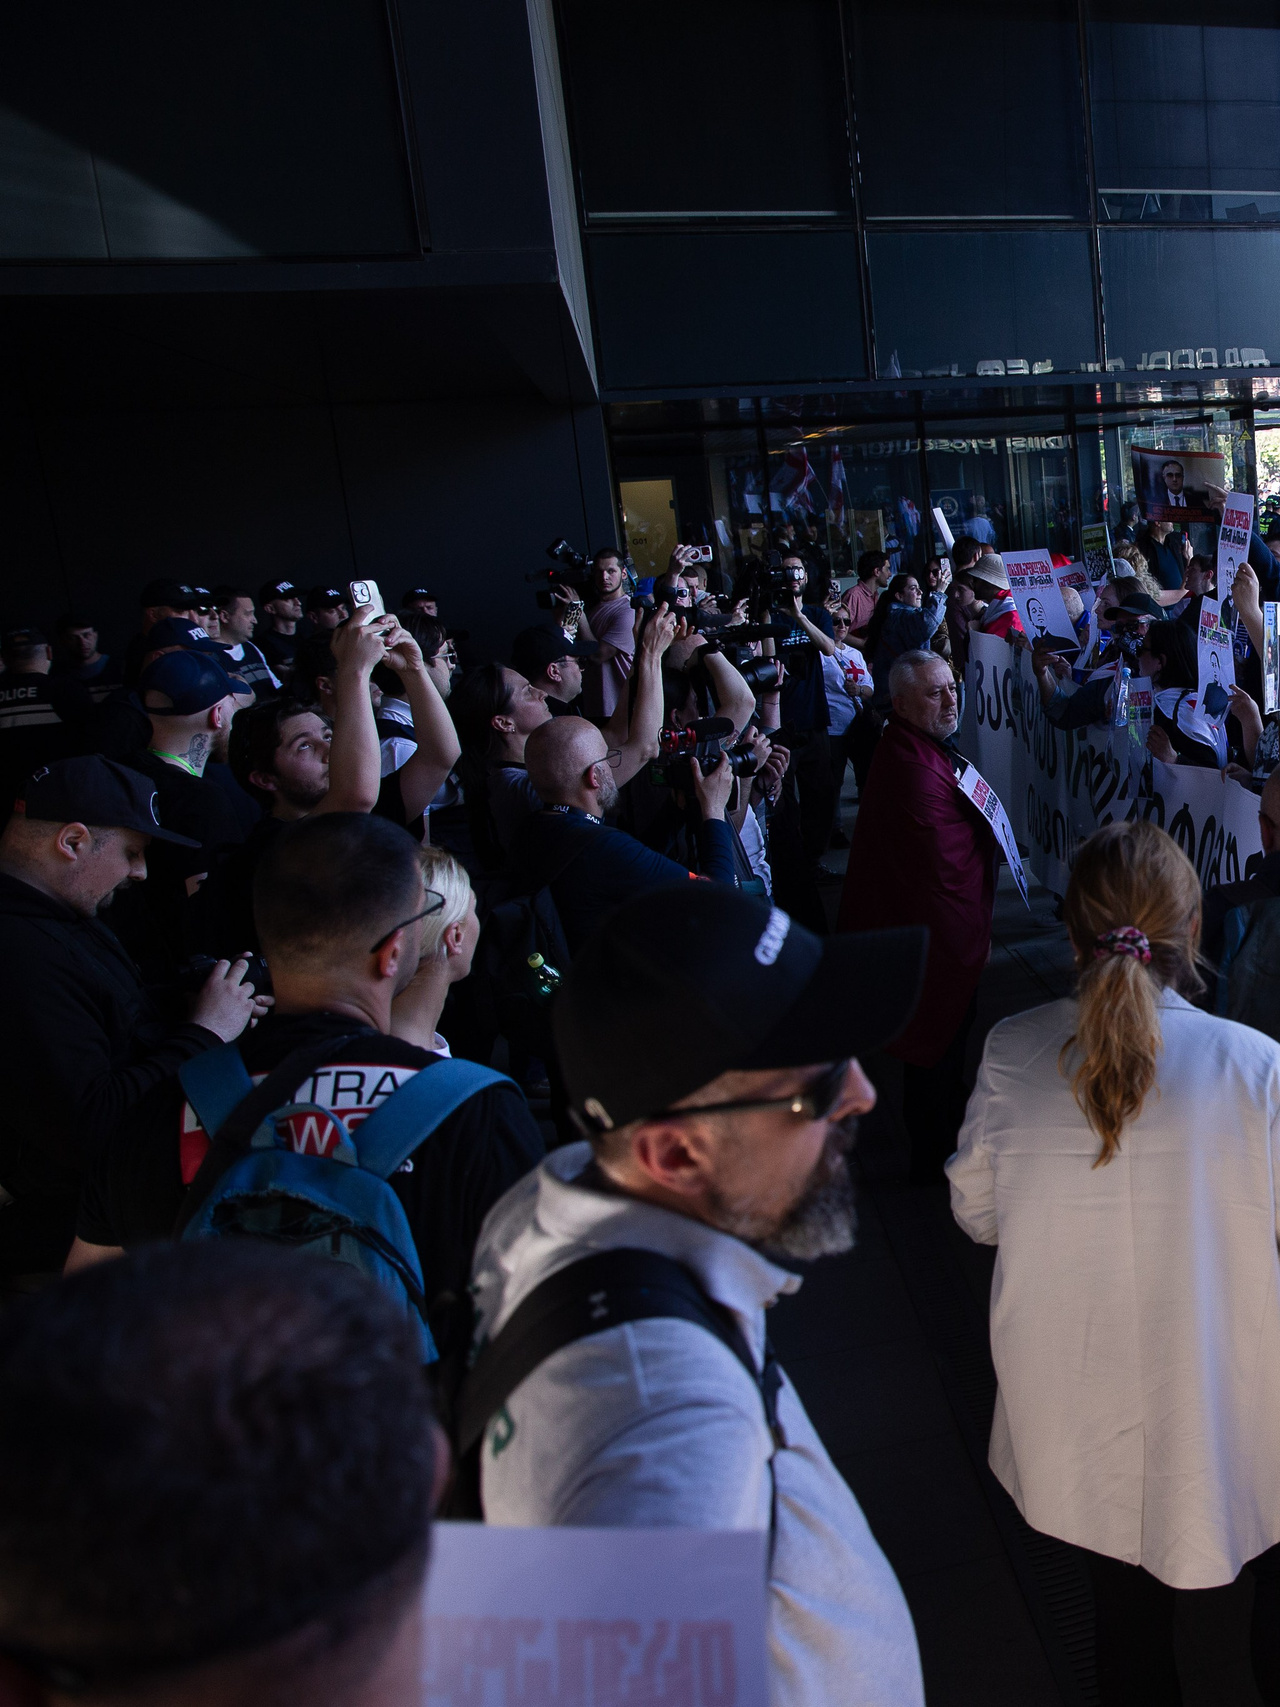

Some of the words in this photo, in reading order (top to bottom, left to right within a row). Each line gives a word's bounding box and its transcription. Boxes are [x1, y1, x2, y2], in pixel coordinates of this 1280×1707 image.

[1006, 560, 1052, 576] თავისუფლება
[0, 686, 38, 701] OLICE
[292, 1071, 399, 1107] TRA
